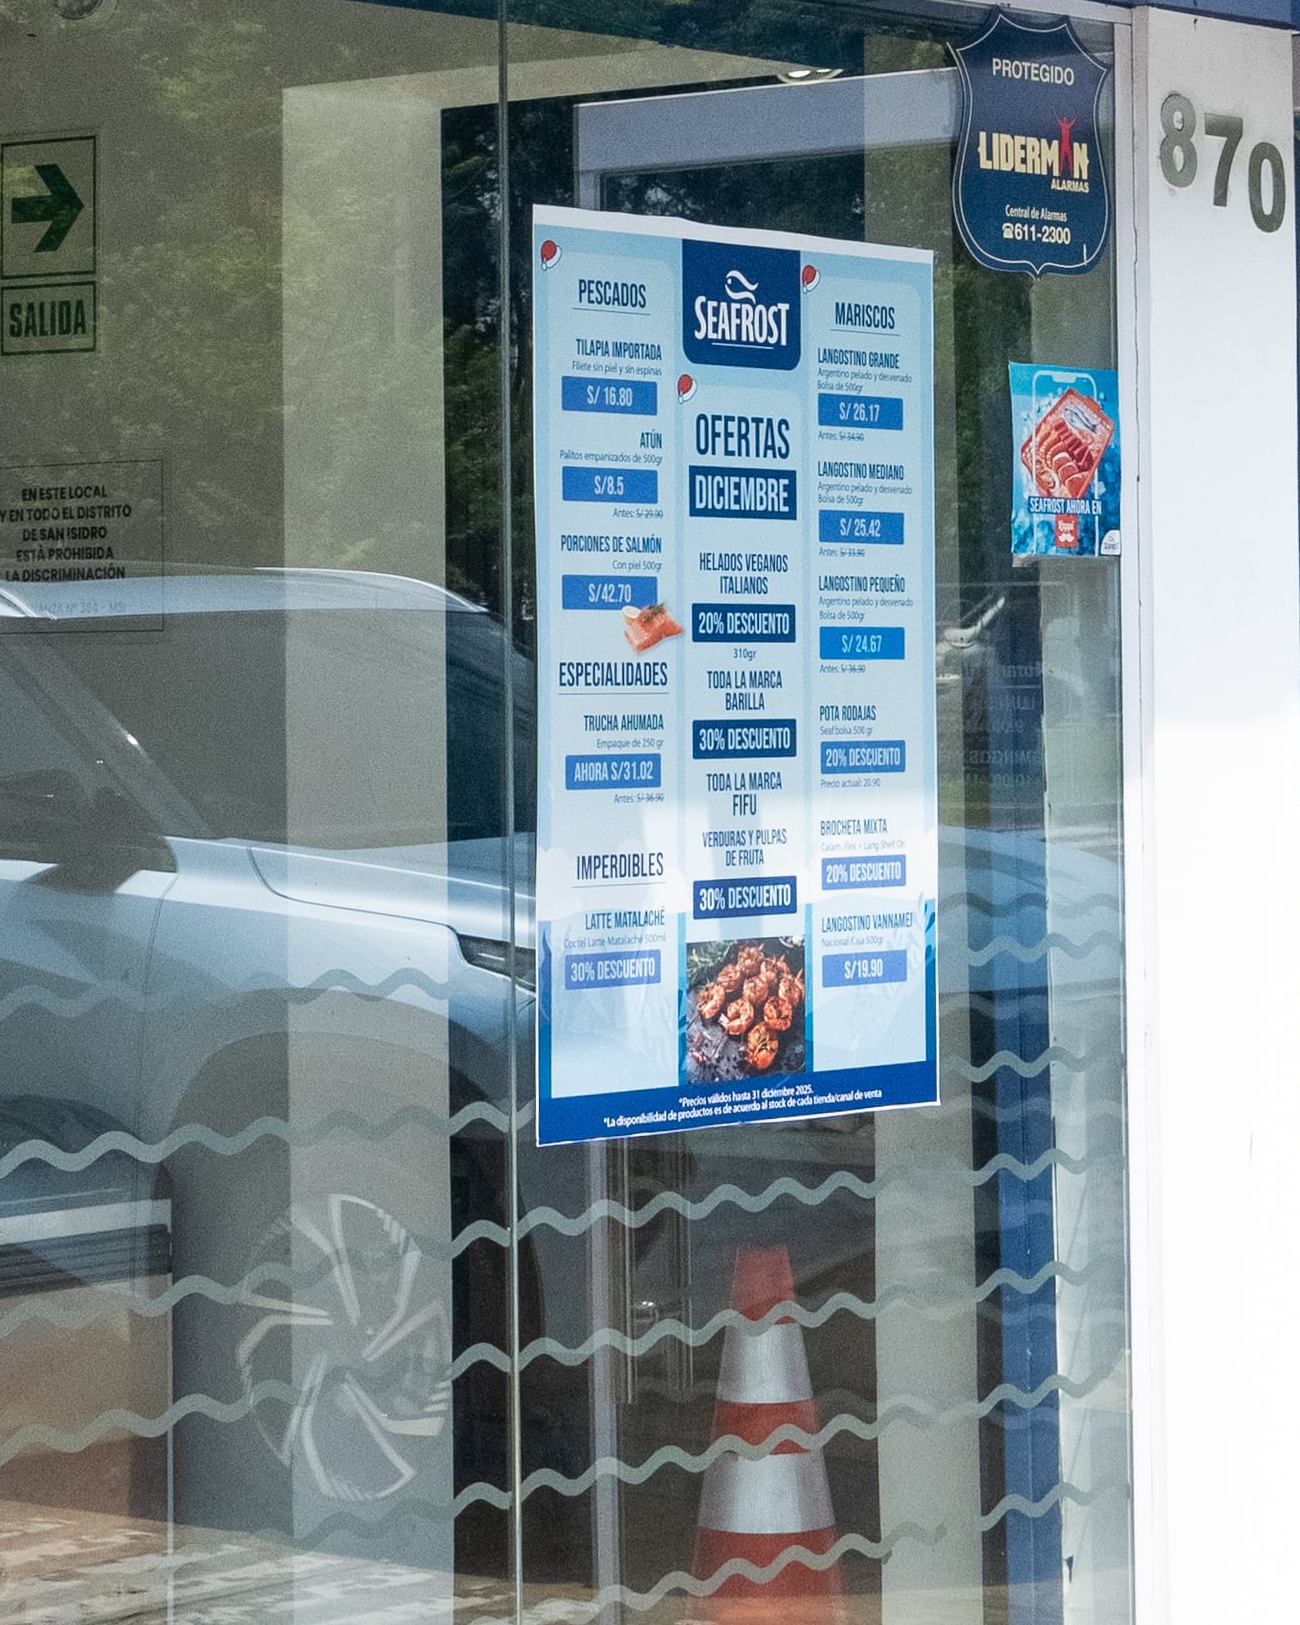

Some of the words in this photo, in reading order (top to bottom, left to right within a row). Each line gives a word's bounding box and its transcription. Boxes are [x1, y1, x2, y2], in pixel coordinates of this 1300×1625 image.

[992, 58, 1074, 86] PROTEGIDO
[1159, 93, 1286, 233] 870
[1051, 179, 1090, 193] ALARMAS
[1005, 204, 1029, 218] Central
[1031, 208, 1039, 219] de
[1040, 208, 1067, 222] Alarmas
[1015, 224, 1071, 244] 611-2300
[579, 279, 646, 308] PESCADOS
[9, 299, 86, 338] SALIDA
[694, 295, 790, 346] SEAFROST
[835, 302, 895, 329] MARISCOS
[576, 339, 609, 358] TILAPIA
[612, 341, 662, 360] IMPORTADA
[818, 348, 866, 366] LANGOSTINO
[869, 351, 899, 369] GRANDE
[572, 361, 591, 372] Filete
[593, 362, 603, 372] sin
[605, 363, 617, 374] piel
[619, 366, 623, 374] y
[625, 364, 634, 374] sin
[637, 366, 662, 376] espinas
[587, 385, 599, 404] S/
[604, 387, 632, 406] 16.80
[839, 402, 851, 419] S/
[854, 403, 880, 422] 26.17
[640, 429, 662, 449] ATÚN
[696, 414, 790, 459] OFERTAS
[818, 461, 867, 479] LANGOSTINO
[869, 464, 904, 480] MEDIANO
[22, 489, 37, 501] EN
[39, 487, 66, 500] ESTE
[69, 485, 107, 499] LOCAL
[594, 475, 624, 495] S/8.5
[695, 475, 789, 512] DICIEMBRE
[0, 510, 7, 522] Y
[9, 509, 24, 522] EN
[26, 508, 60, 521] TODO
[63, 507, 74, 519] EL
[77, 504, 131, 519] DISTRITO
[1030, 497, 1064, 513] SEAFROST
[1066, 499, 1090, 514] AHORA
[1092, 500, 1102, 514] EN
[23, 529, 37, 541] DE
[40, 528, 64, 541] SAN
[67, 526, 107, 540] ISIDRO
[840, 518, 851, 536] S/
[854, 519, 880, 537] 25.42
[561, 535, 610, 552] PORCIONES
[613, 537, 624, 553] DE
[626, 534, 662, 553] SALMÓN
[17, 546, 44, 562] ESTÁ
[48, 546, 114, 560] PROHIBIDA
[700, 552, 742, 571] HELADOS
[745, 554, 788, 572] VEGANOS
[6, 570, 20, 582] LA
[22, 563, 125, 582] DISCRIMINACIÓN
[612, 560, 626, 570] Con
[629, 560, 641, 572] piel
[643, 561, 662, 572] 500gr
[588, 583, 631, 603] S/42.70
[720, 576, 768, 594] ITALIANOS
[819, 575, 867, 592] LANGOSTINO
[870, 574, 905, 593] PEQUEÑO
[699, 611, 724, 634] 20%
[727, 612, 789, 634] DESCUENTO
[842, 634, 853, 653] S/
[856, 635, 882, 653] 24.67
[733, 648, 756, 661] 310gr
[559, 662, 667, 686] ESPECIALIDADES
[707, 671, 731, 689] TODA
[735, 671, 746, 688] LA
[749, 671, 782, 688] MARCA
[726, 693, 765, 710] BARILLA
[584, 715, 618, 731] TRUCHA
[621, 714, 664, 730] AHUMADA
[820, 706, 840, 721] POTA
[842, 706, 876, 721] RODAJAS
[699, 728, 725, 750] 30%
[728, 727, 790, 750] DESCUENTO
[826, 748, 847, 767] 20%
[849, 748, 900, 766] DESCUENTO
[574, 763, 608, 782] AHORA
[611, 761, 653, 780] S/31.02
[707, 773, 731, 791] TODA
[734, 773, 745, 791] LA
[749, 772, 782, 790] MARCA
[733, 794, 757, 815] FIFU
[821, 820, 861, 835] BROCHETA
[864, 819, 887, 834] MIXTA
[703, 830, 746, 847] VERDURAS
[748, 830, 754, 845] Y
[756, 829, 787, 845] PULPAS
[577, 852, 663, 880] IMPERDIBLES
[726, 851, 736, 866] DE
[739, 849, 764, 866] FRUTA
[827, 864, 847, 883] 20%
[850, 862, 901, 882] DESCUENTO
[699, 888, 725, 911] 30%
[729, 884, 791, 909] DESCUENTO
[586, 912, 612, 930] LATTE
[614, 906, 665, 928] MATALACHÉ
[821, 913, 871, 932] LANGOSTINO
[873, 912, 913, 929] VANNAMEI
[571, 961, 594, 982] 30%
[598, 958, 655, 980] DESCUENTO
[844, 959, 883, 979] S/19.90
